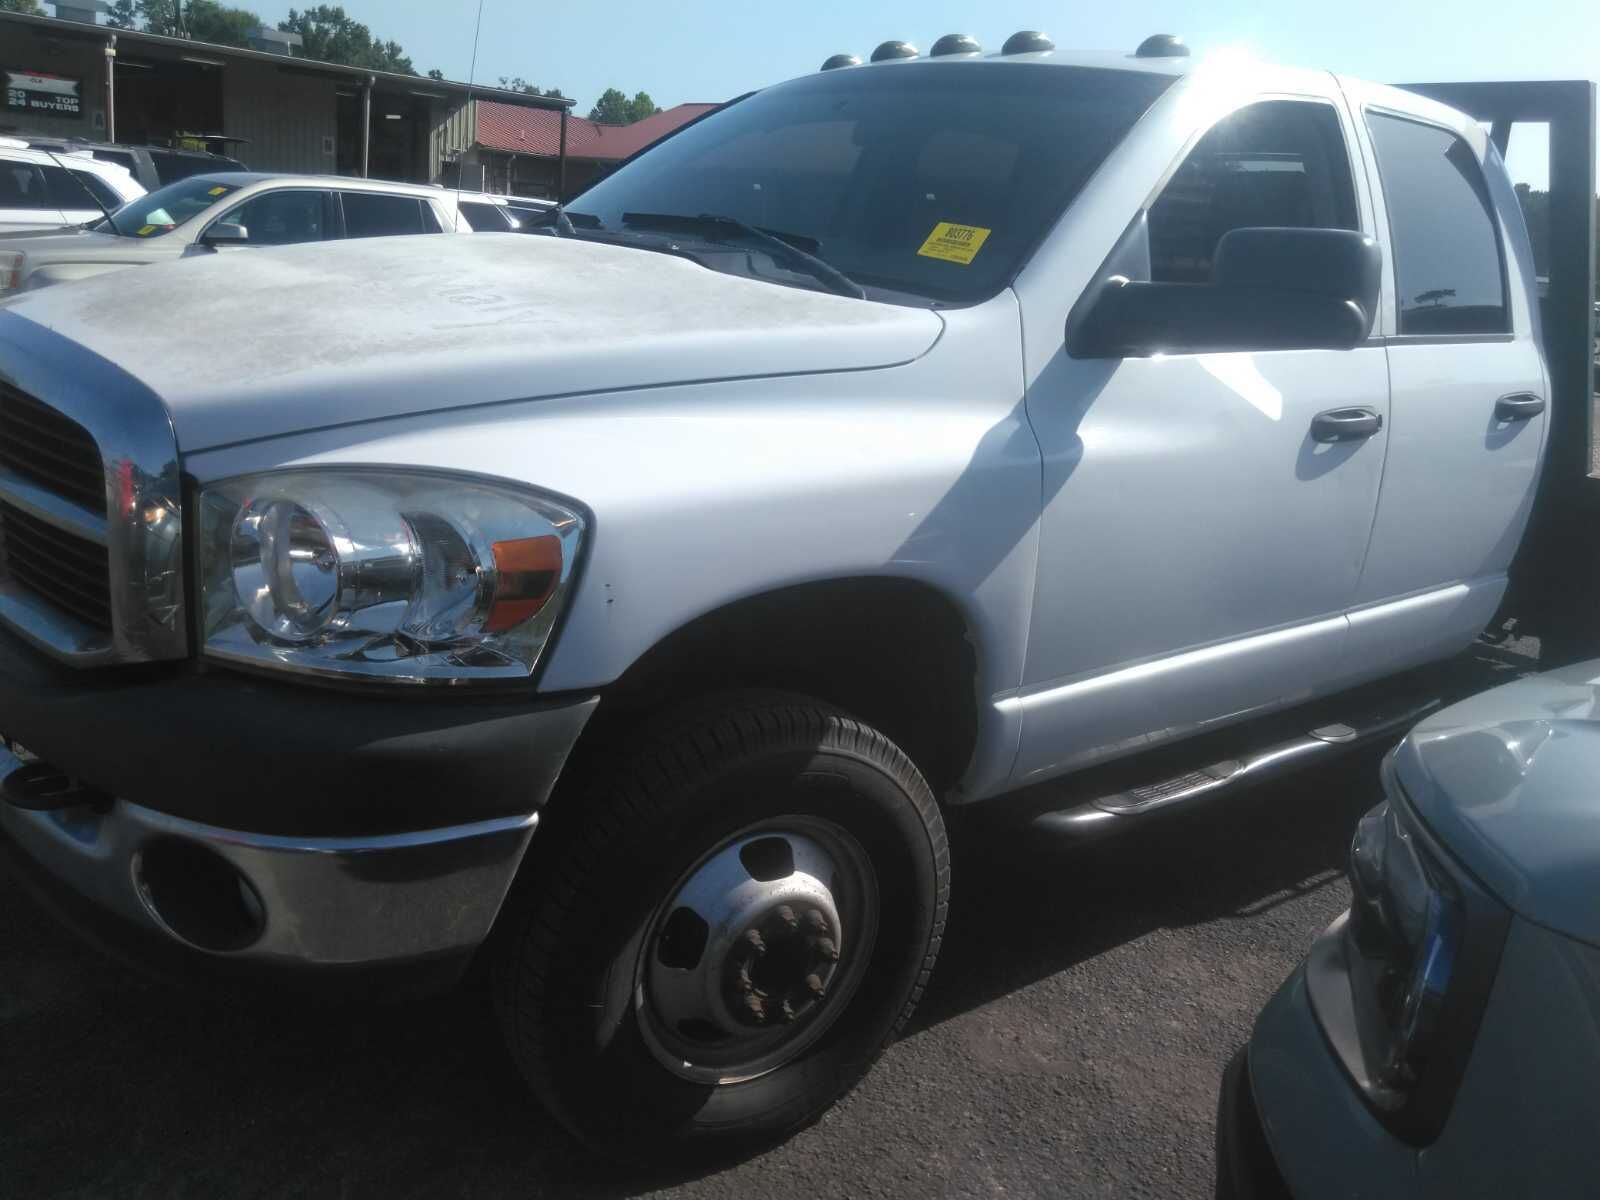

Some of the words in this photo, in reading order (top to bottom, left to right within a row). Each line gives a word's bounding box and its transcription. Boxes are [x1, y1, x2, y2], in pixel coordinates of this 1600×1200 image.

[8, 89, 25, 98] 20
[56, 96, 79, 104] TOP
[31, 100, 79, 112] BUYERS
